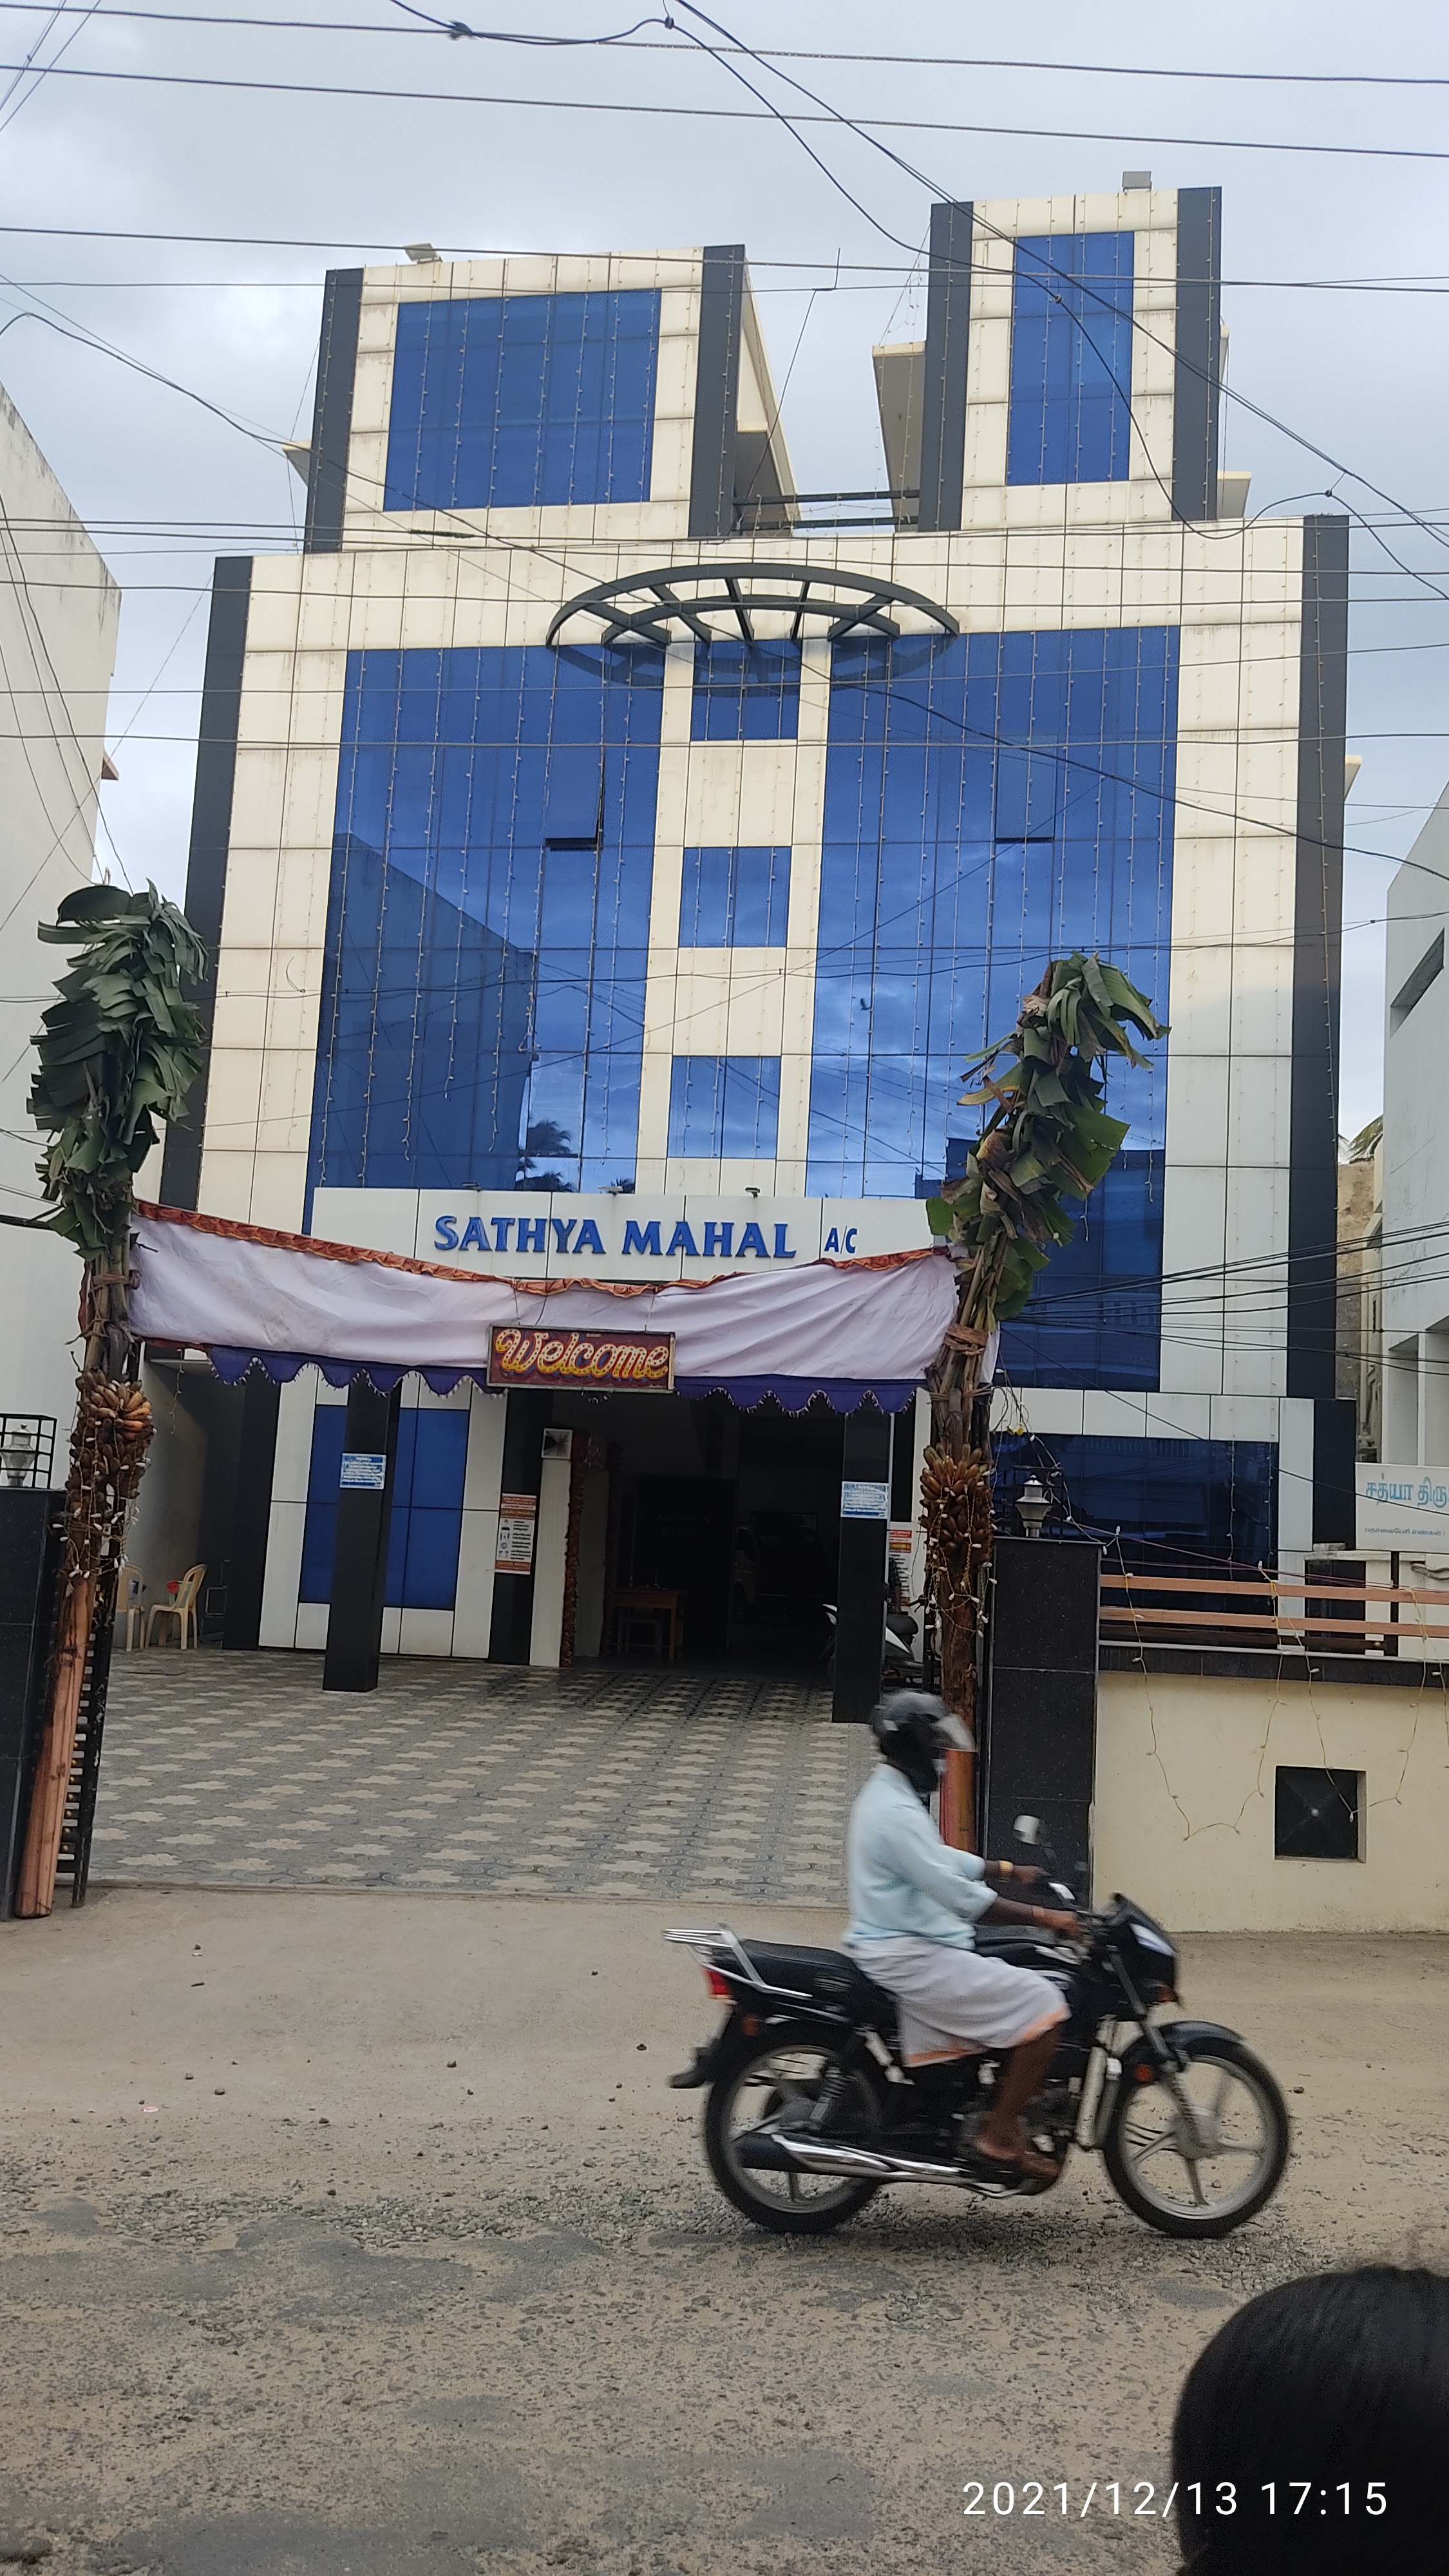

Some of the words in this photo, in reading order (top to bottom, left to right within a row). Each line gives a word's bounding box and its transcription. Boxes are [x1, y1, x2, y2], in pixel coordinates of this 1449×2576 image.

[433, 1215, 606, 1254] SATHYA
[621, 1220, 797, 1258] MAHAL
[824, 1226, 858, 1255] A/C
[495, 1328, 669, 1379] Welcome
[1366, 1472, 1414, 1506] சத்யா
[1417, 1476, 1449, 1508] திரு
